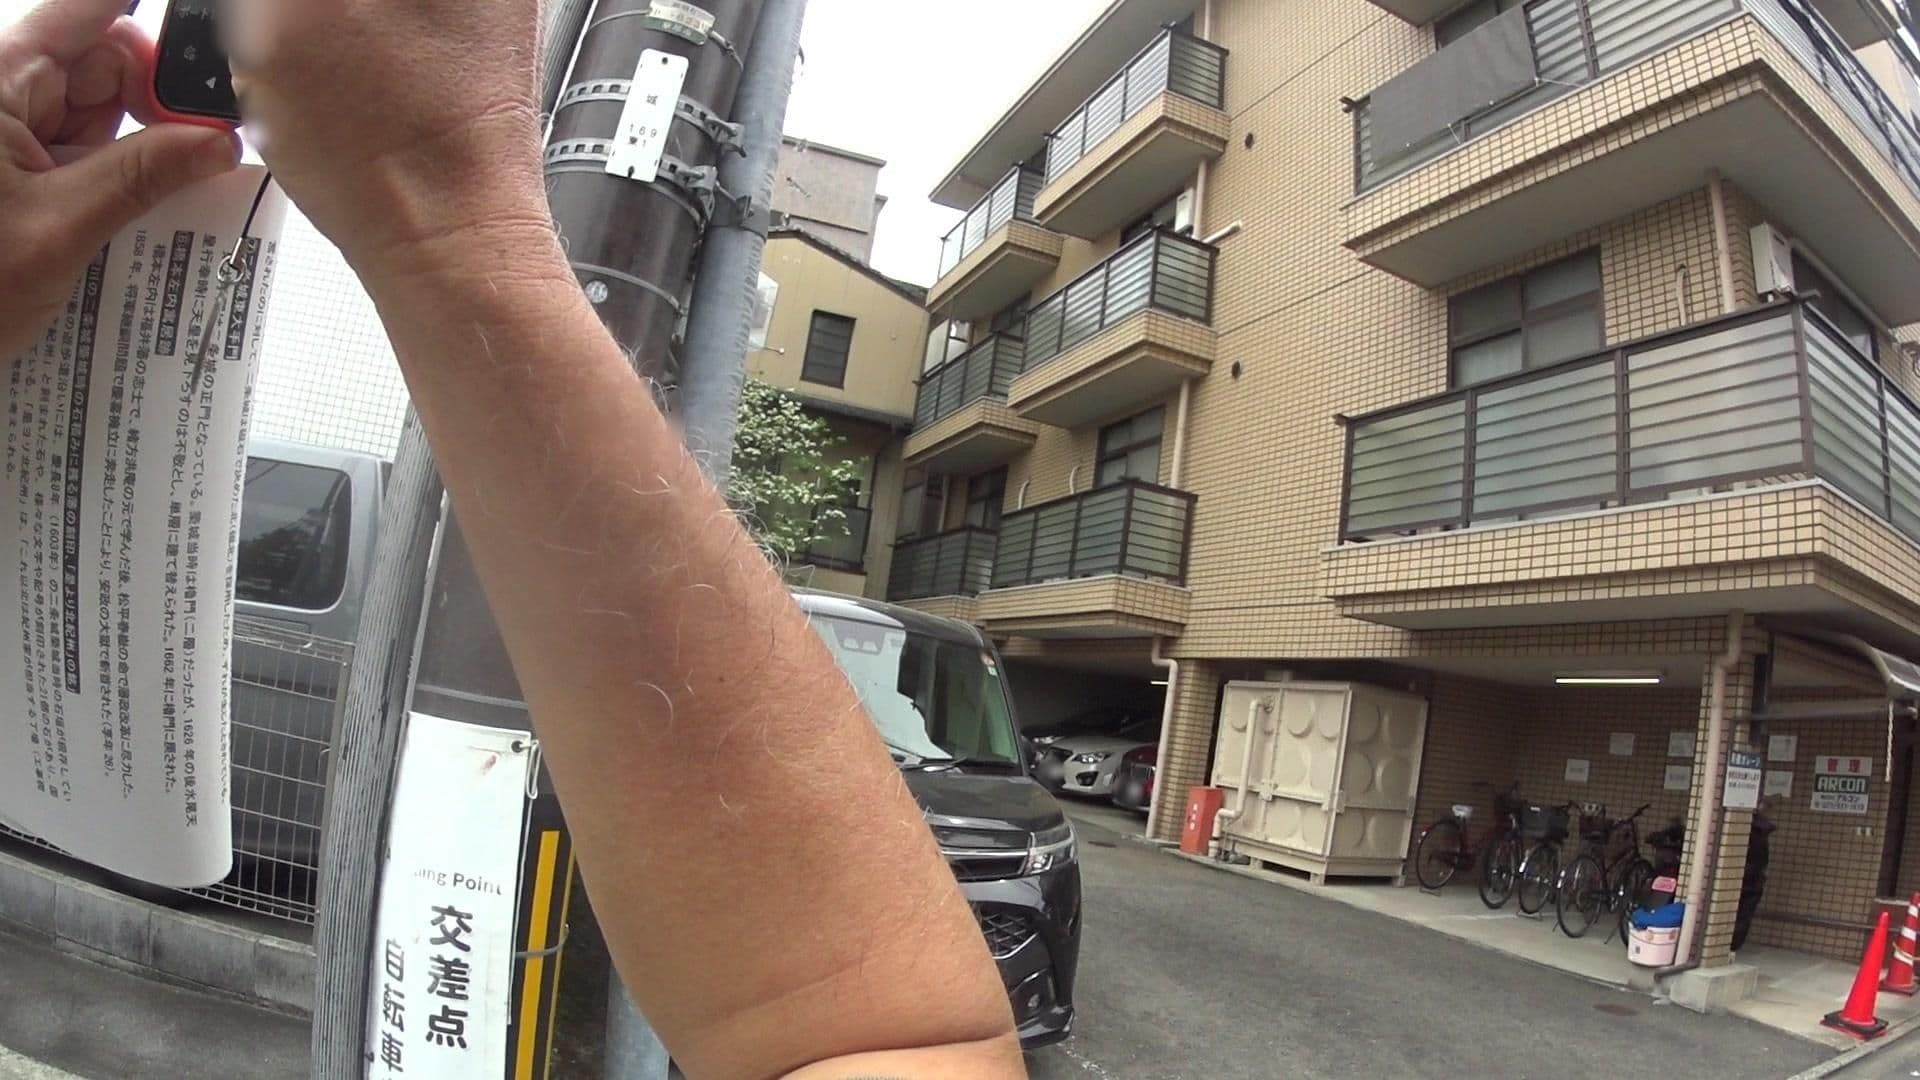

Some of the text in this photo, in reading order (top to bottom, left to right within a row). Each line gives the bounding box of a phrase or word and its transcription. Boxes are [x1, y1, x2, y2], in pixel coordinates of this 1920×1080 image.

[1817, 776, 1866, 793] ARCON
[427, 905, 473, 1049] 交差点
